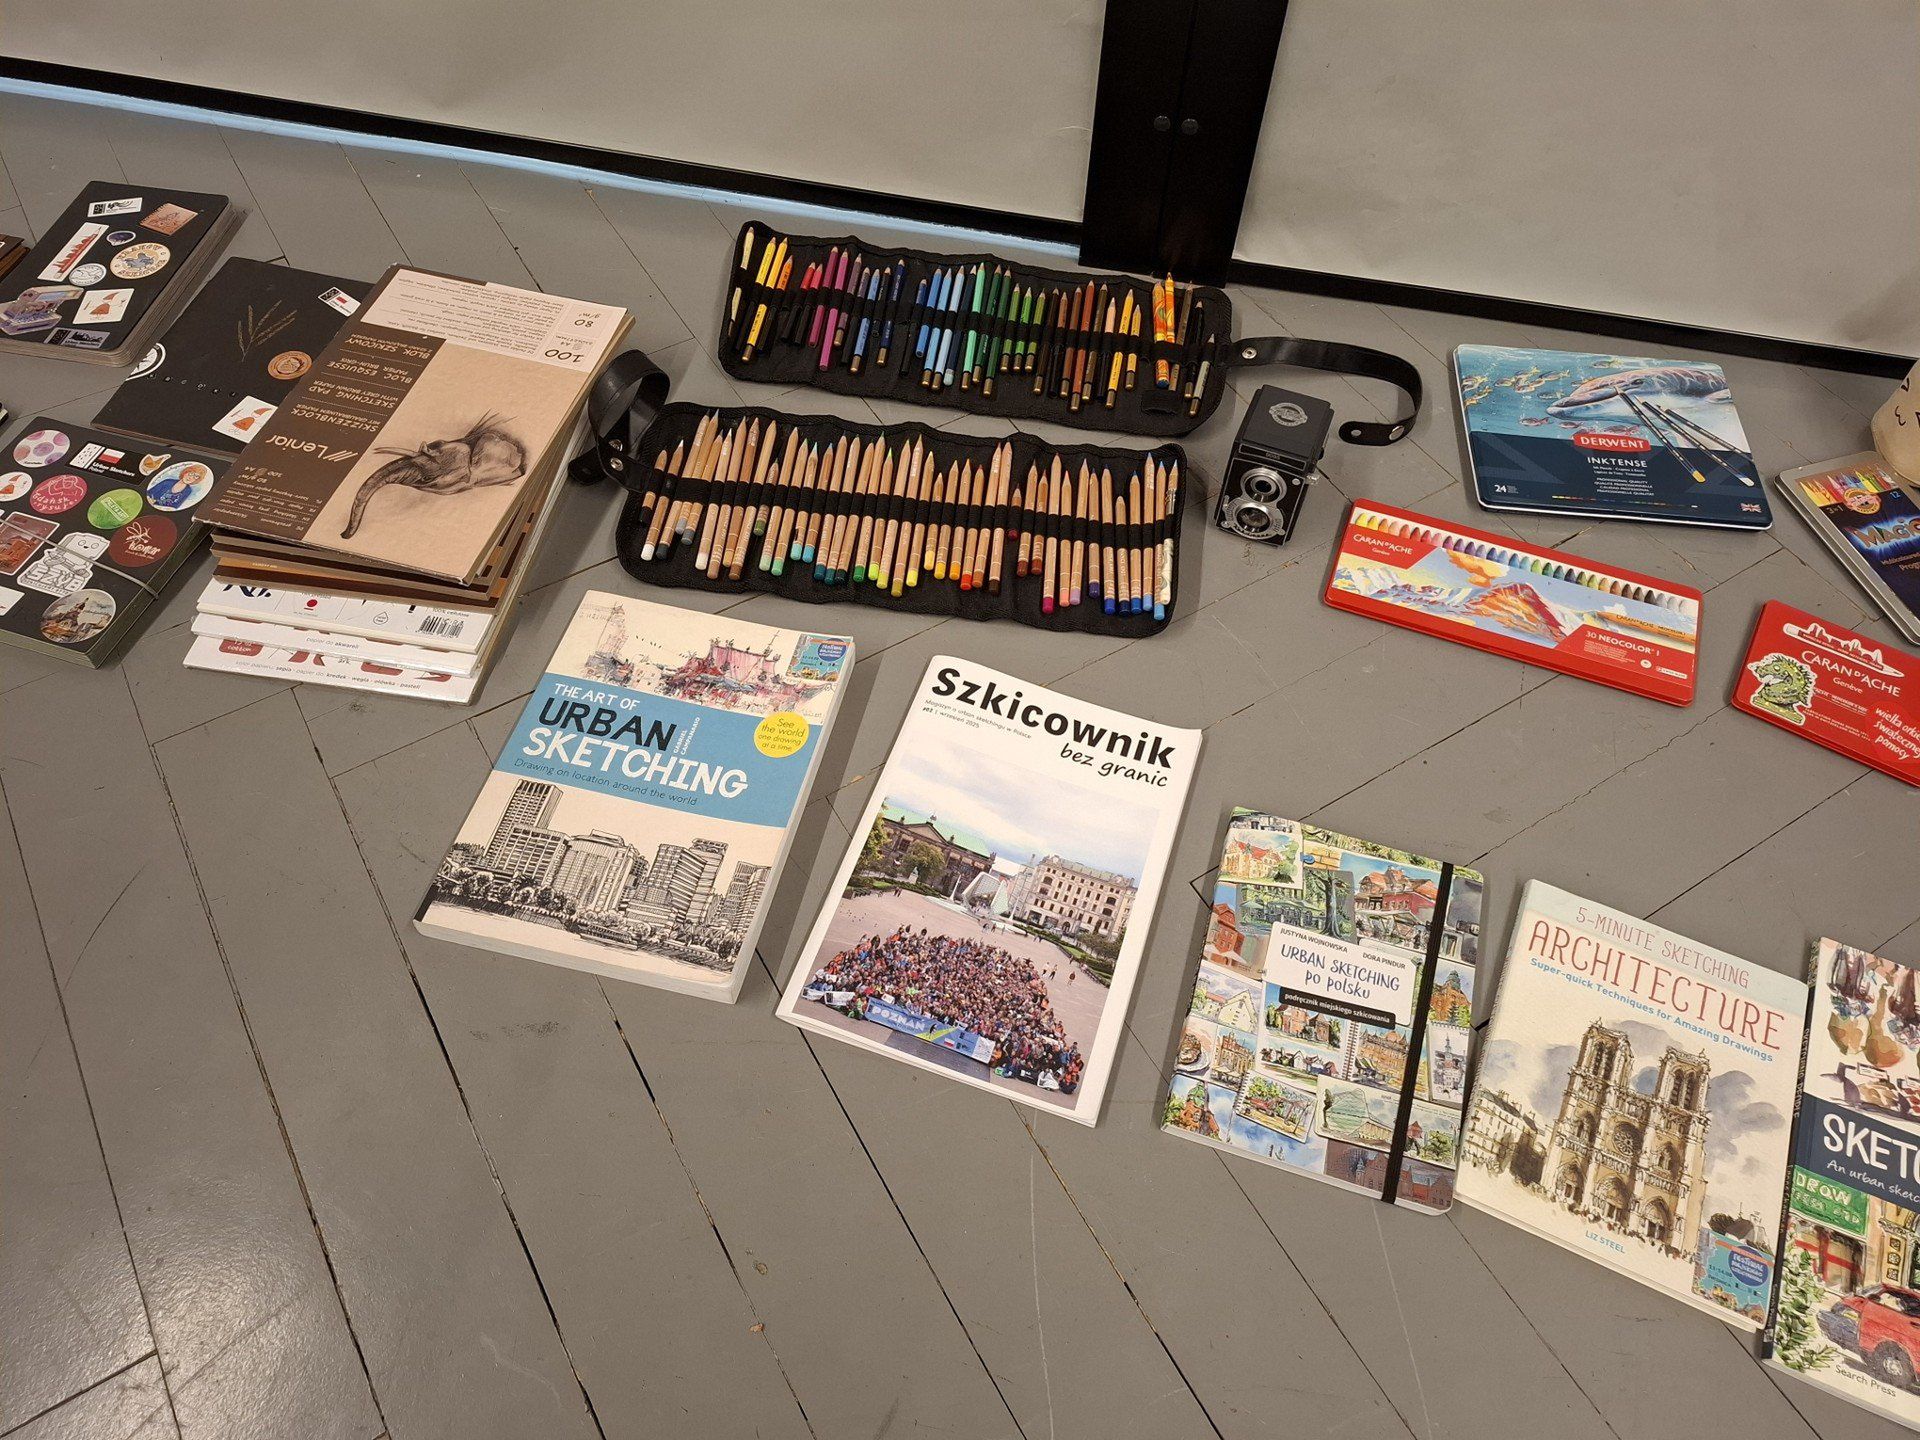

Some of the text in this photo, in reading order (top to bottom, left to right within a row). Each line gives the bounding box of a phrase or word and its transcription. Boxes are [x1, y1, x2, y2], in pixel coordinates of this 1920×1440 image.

[574, 319, 594, 328] 80
[345, 337, 430, 359] BLOK SZKICOWY
[545, 349, 584, 363] 100
[327, 361, 413, 384] BLOC ESQUISSE
[309, 385, 395, 409] SKETCHING PAD
[291, 407, 379, 432] SKIZZENBLOCK
[265, 434, 328, 459] Leniar
[1580, 436, 1644, 449] DERWENT
[1587, 456, 1648, 469] INKTENSE
[1494, 484, 1507, 494] 24
[1890, 490, 1901, 499] 12
[1353, 533, 1384, 547] CARAN
[1585, 630, 1597, 640] 30
[1598, 633, 1652, 655] NEOCOLOR
[1802, 650, 1852, 678] CARAN
[555, 683, 641, 712] THE ART OF
[1833, 677, 1863, 694] Genève
[538, 697, 678, 753] URBAN
[777, 718, 795, 728] See
[932, 667, 1177, 769] Szkicownik
[1875, 707, 1903, 728] wielka
[761, 723, 806, 738] the world
[773, 735, 801, 746] drawing
[1875, 735, 1910, 760] pomocy
[523, 727, 750, 799] SKETCHING
[1060, 743, 1168, 788] bez granic
[513, 757, 698, 807] Drawing on location around the world
[1280, 928, 1348, 953] JUSTYNA WOJNOWSKA
[1576, 905, 1750, 989] 5-MINUTE SKETCHING
[1281, 944, 1401, 991] URBAN SKETCHING
[1362, 952, 1407, 970] DORA PINDUR
[1305, 969, 1371, 1000] po polsku
[1528, 920, 1785, 1051] ARCHITECTURE
[1284, 992, 1391, 1023] podręcznik miejskiego szkicowania
[1530, 957, 1773, 1063] Super-quick Techniques for Amazing Drawings
[1826, 1160, 1847, 1175] An
[1849, 1169, 1885, 1191] urban
[1585, 1230, 1626, 1254] LIZ STEEL
[1835, 1364, 1897, 1398] Search Press
